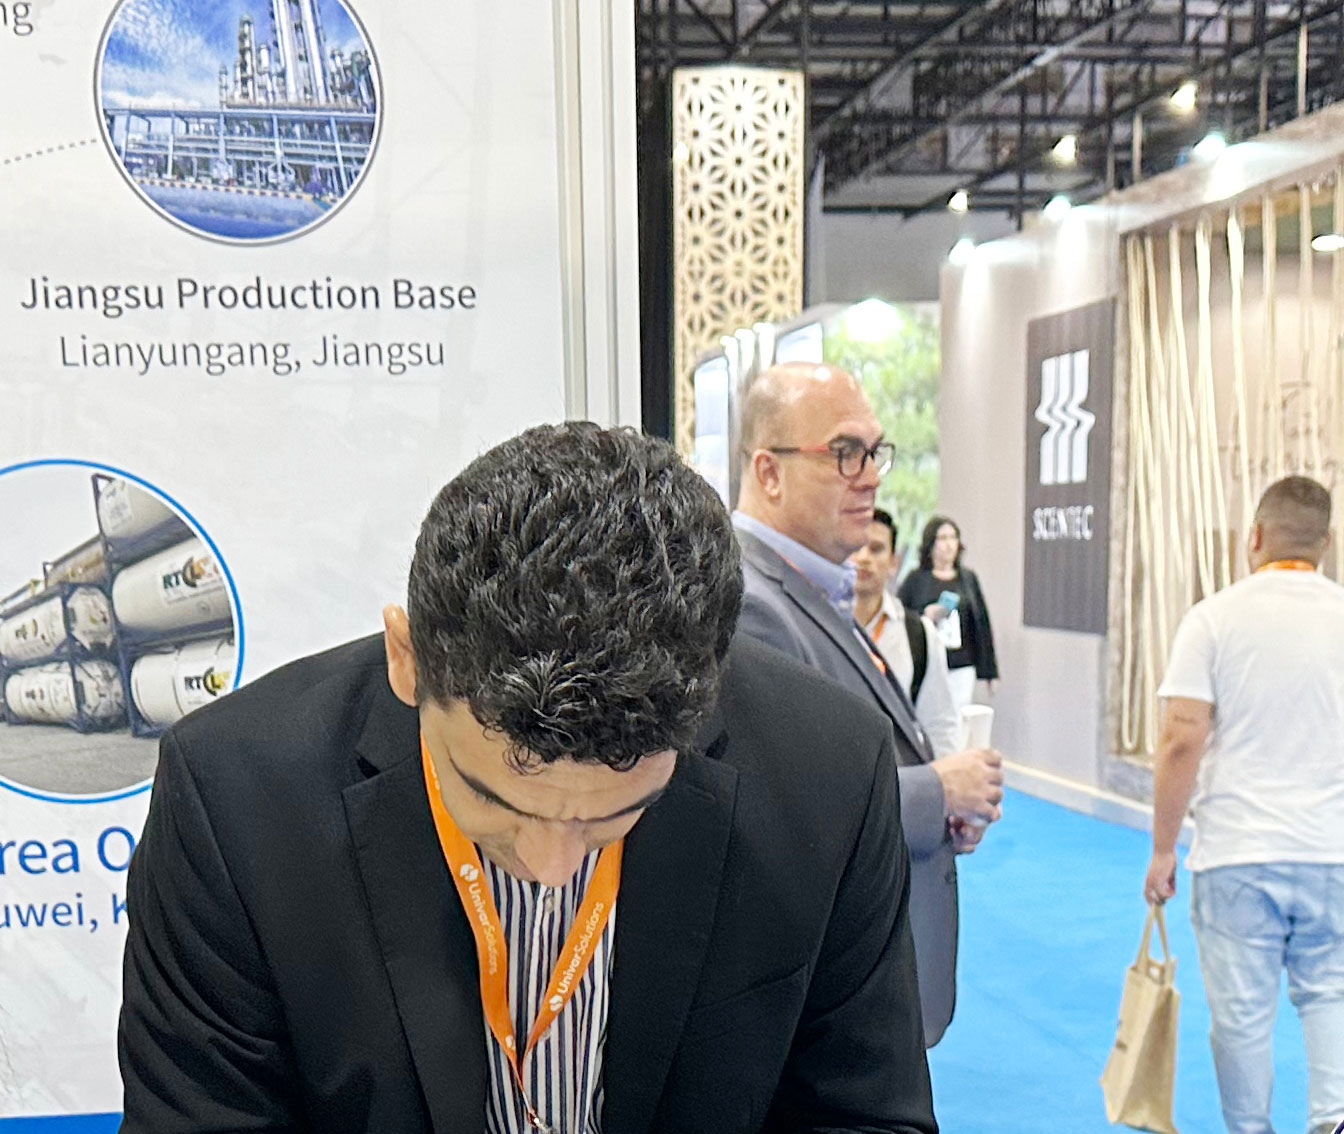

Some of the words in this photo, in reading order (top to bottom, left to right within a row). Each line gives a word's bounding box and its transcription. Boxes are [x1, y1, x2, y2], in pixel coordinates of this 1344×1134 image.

[21, 277, 164, 317] Jiangsu
[177, 276, 381, 311] Production
[392, 277, 477, 311] Base
[60, 334, 303, 374] Lianyungang,
[312, 334, 445, 369] Jiangsu
[1033, 505, 1094, 541] SCENTEC
